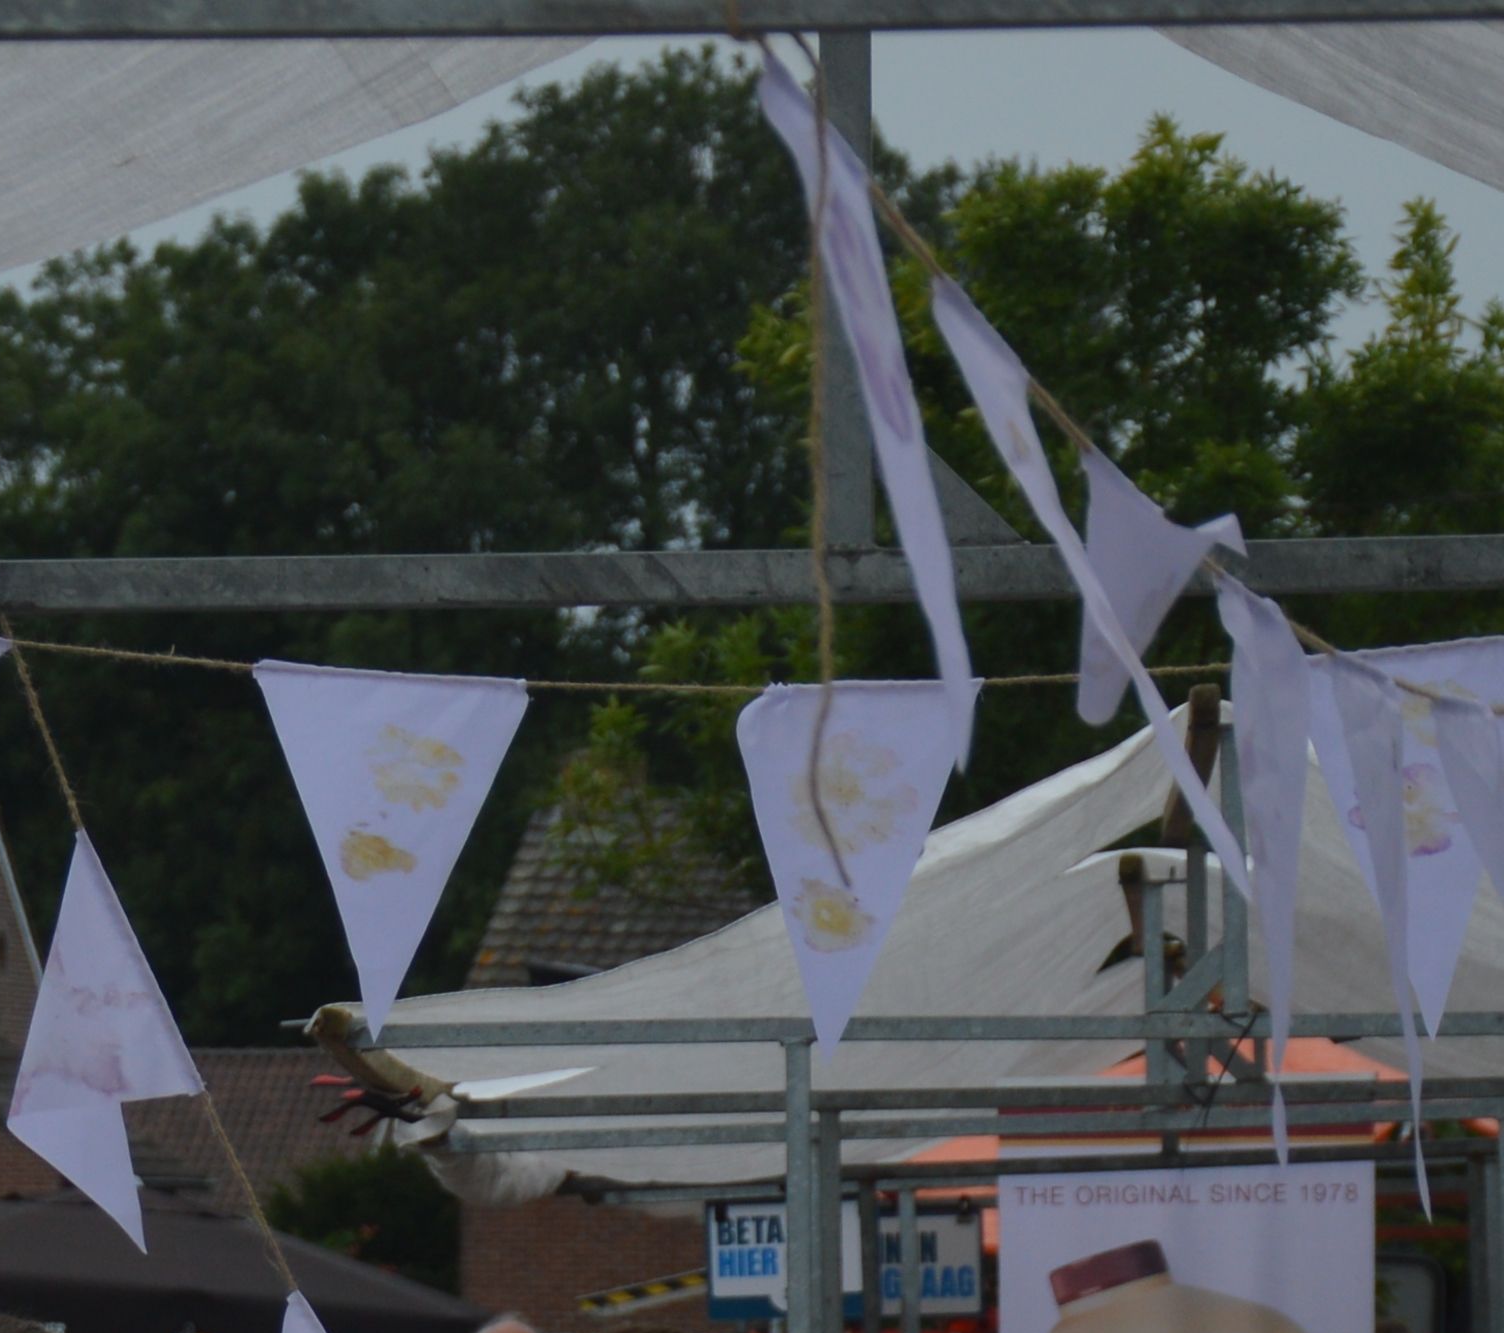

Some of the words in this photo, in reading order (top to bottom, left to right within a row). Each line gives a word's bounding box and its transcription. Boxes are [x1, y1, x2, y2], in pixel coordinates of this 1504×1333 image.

[1015, 1185, 1065, 1205] THE
[1075, 1184, 1199, 1205] ORIGINAL
[1209, 1182, 1287, 1203] SINCE
[1300, 1182, 1359, 1202] 1978
[718, 1247, 779, 1277] HIER
[883, 1265, 975, 1298] GAAG
